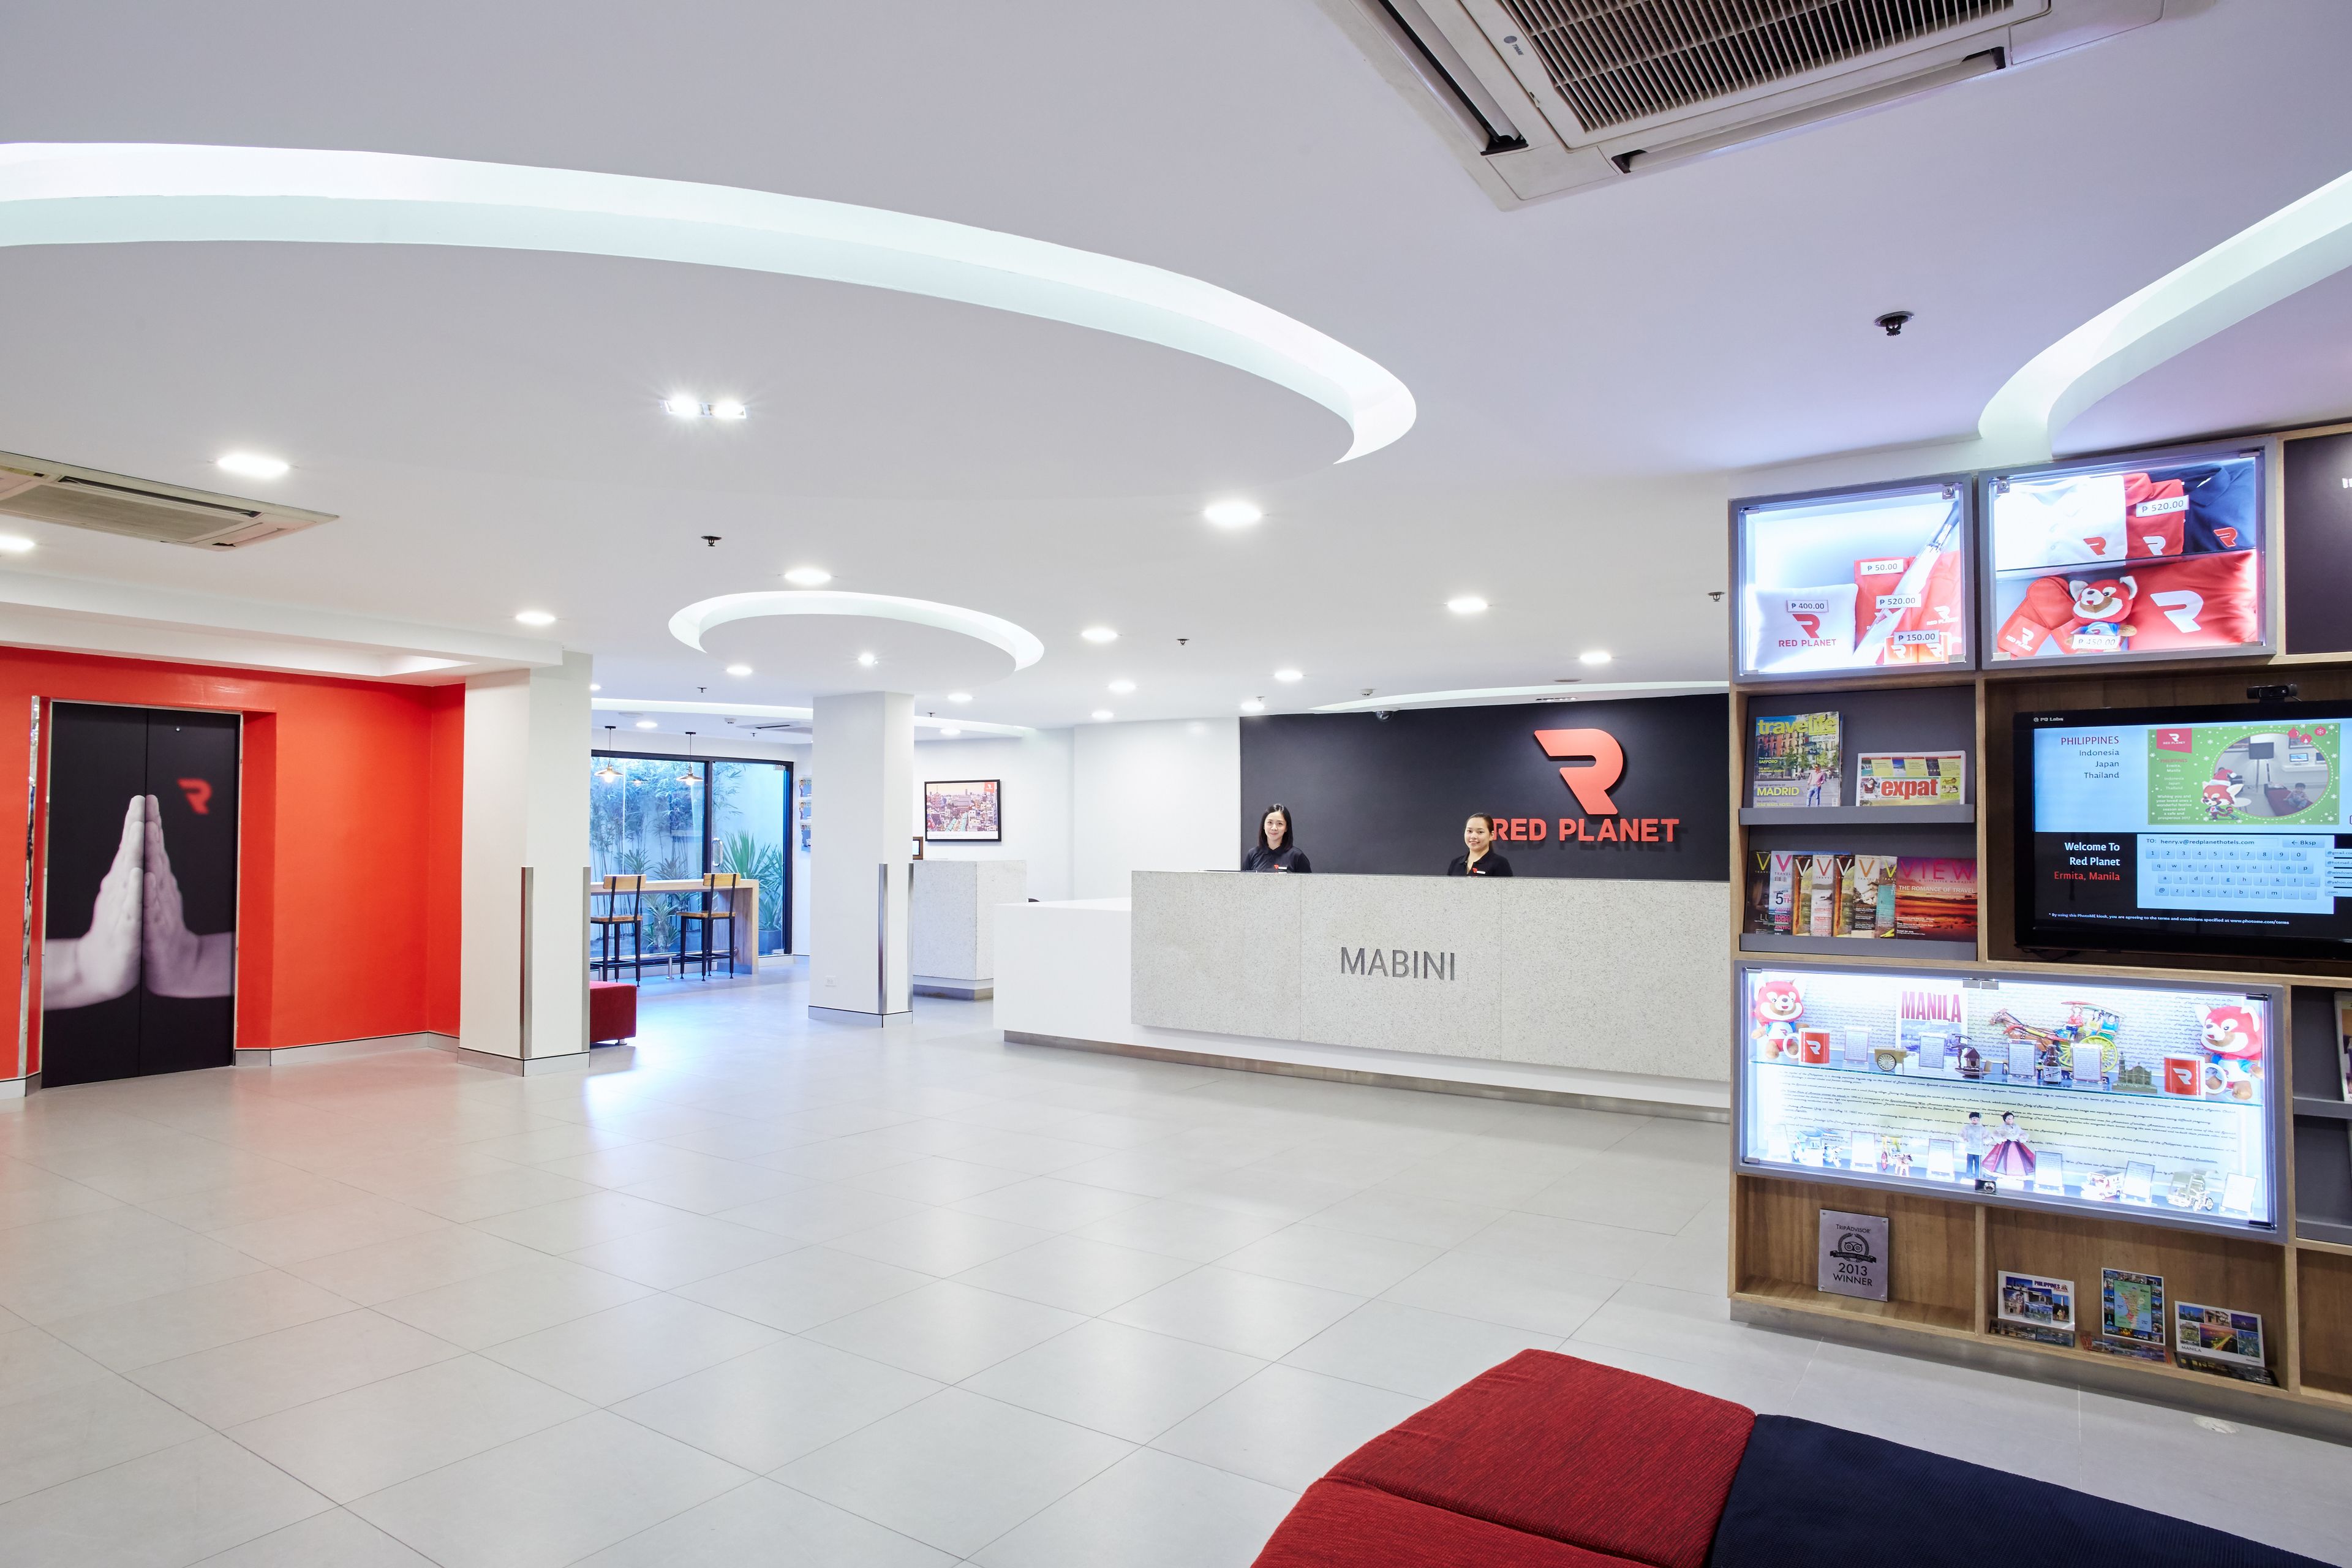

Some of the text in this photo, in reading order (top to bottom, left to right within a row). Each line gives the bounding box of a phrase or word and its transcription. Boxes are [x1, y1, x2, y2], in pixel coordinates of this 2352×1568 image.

[2151, 500, 2184, 512] 520.00
[2061, 736, 2119, 745] PHILIPPINES
[1757, 787, 1800, 796] MADRID
[1881, 779, 1938, 799] expat
[1493, 818, 1679, 842] RED PLANET
[2065, 842, 2106, 851] Welcome
[2070, 857, 2087, 865] Red
[1901, 859, 1975, 880] VIEW
[2054, 872, 2086, 881] Ermita,
[1776, 892, 1784, 905] 5
[1341, 947, 1455, 981] MABINI
[1901, 990, 1962, 1023] MANILA
[1839, 1262, 1868, 1276] 2013
[1833, 1273, 1872, 1286] WINNER
